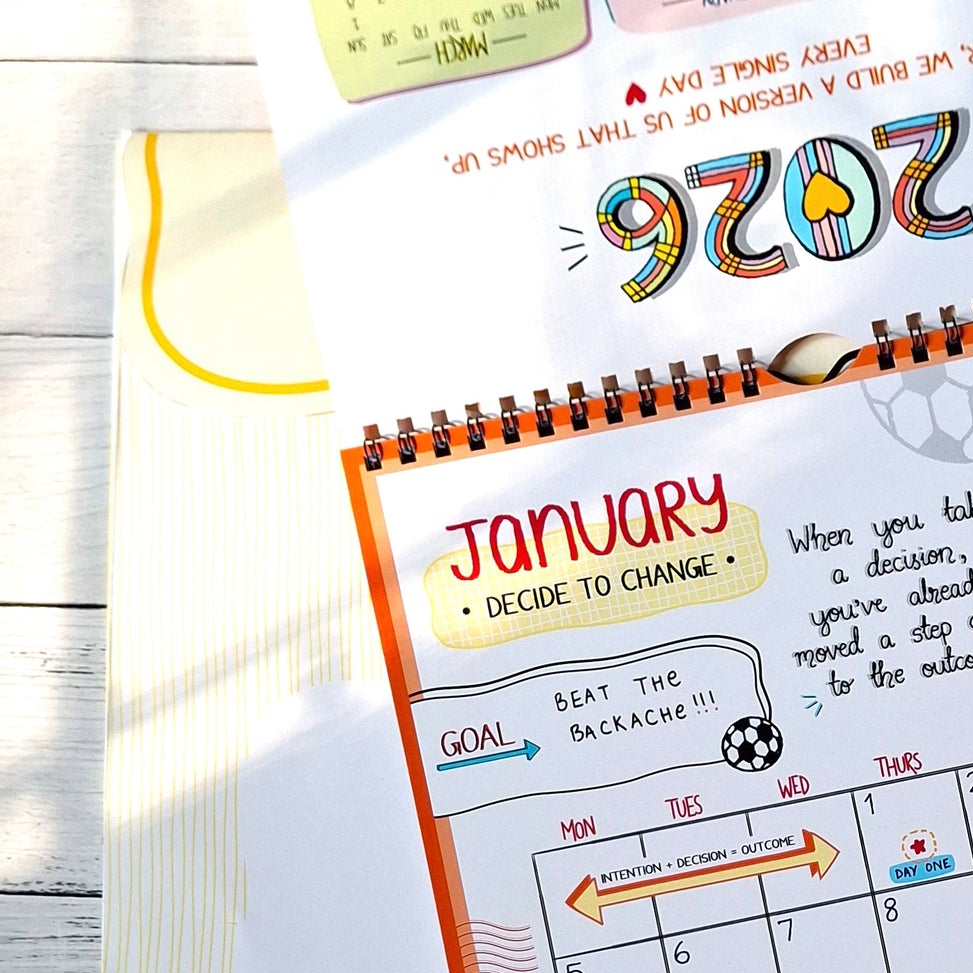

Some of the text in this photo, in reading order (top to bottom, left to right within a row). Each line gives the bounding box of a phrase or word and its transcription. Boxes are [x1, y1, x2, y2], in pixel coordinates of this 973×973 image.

[659, 34, 872, 98] EVERY SINGLE DAY
[847, 60, 908, 90] BUILD
[918, 51, 953, 76] WE
[720, 84, 813, 118] VERSION
[821, 75, 835, 95] A
[644, 111, 673, 133] US
[684, 103, 711, 126] OF
[489, 134, 566, 166] SHOWS
[577, 119, 636, 149] THAT
[787, 522, 853, 554] When
[871, 514, 925, 549] you
[831, 546, 967, 585] a decision,
[486, 553, 718, 618] DECIDE TO CHANGE
[792, 626, 864, 668] moved
[878, 634, 895, 650] a
[910, 614, 952, 646] step
[826, 669, 855, 697] to
[868, 660, 905, 689] the
[555, 685, 610, 712] BEAT
[440, 721, 516, 757] GOAL
[561, 815, 597, 842] MON
[665, 795, 704, 820] TUES
[777, 775, 810, 799] WED
[873, 752, 922, 778] THURS
[863, 792, 875, 815] 1
[600, 862, 662, 884] INTENTION
[676, 849, 727, 869] DECISION
[741, 835, 796, 855] OUTCOME
[894, 857, 952, 880] DAY ONE
